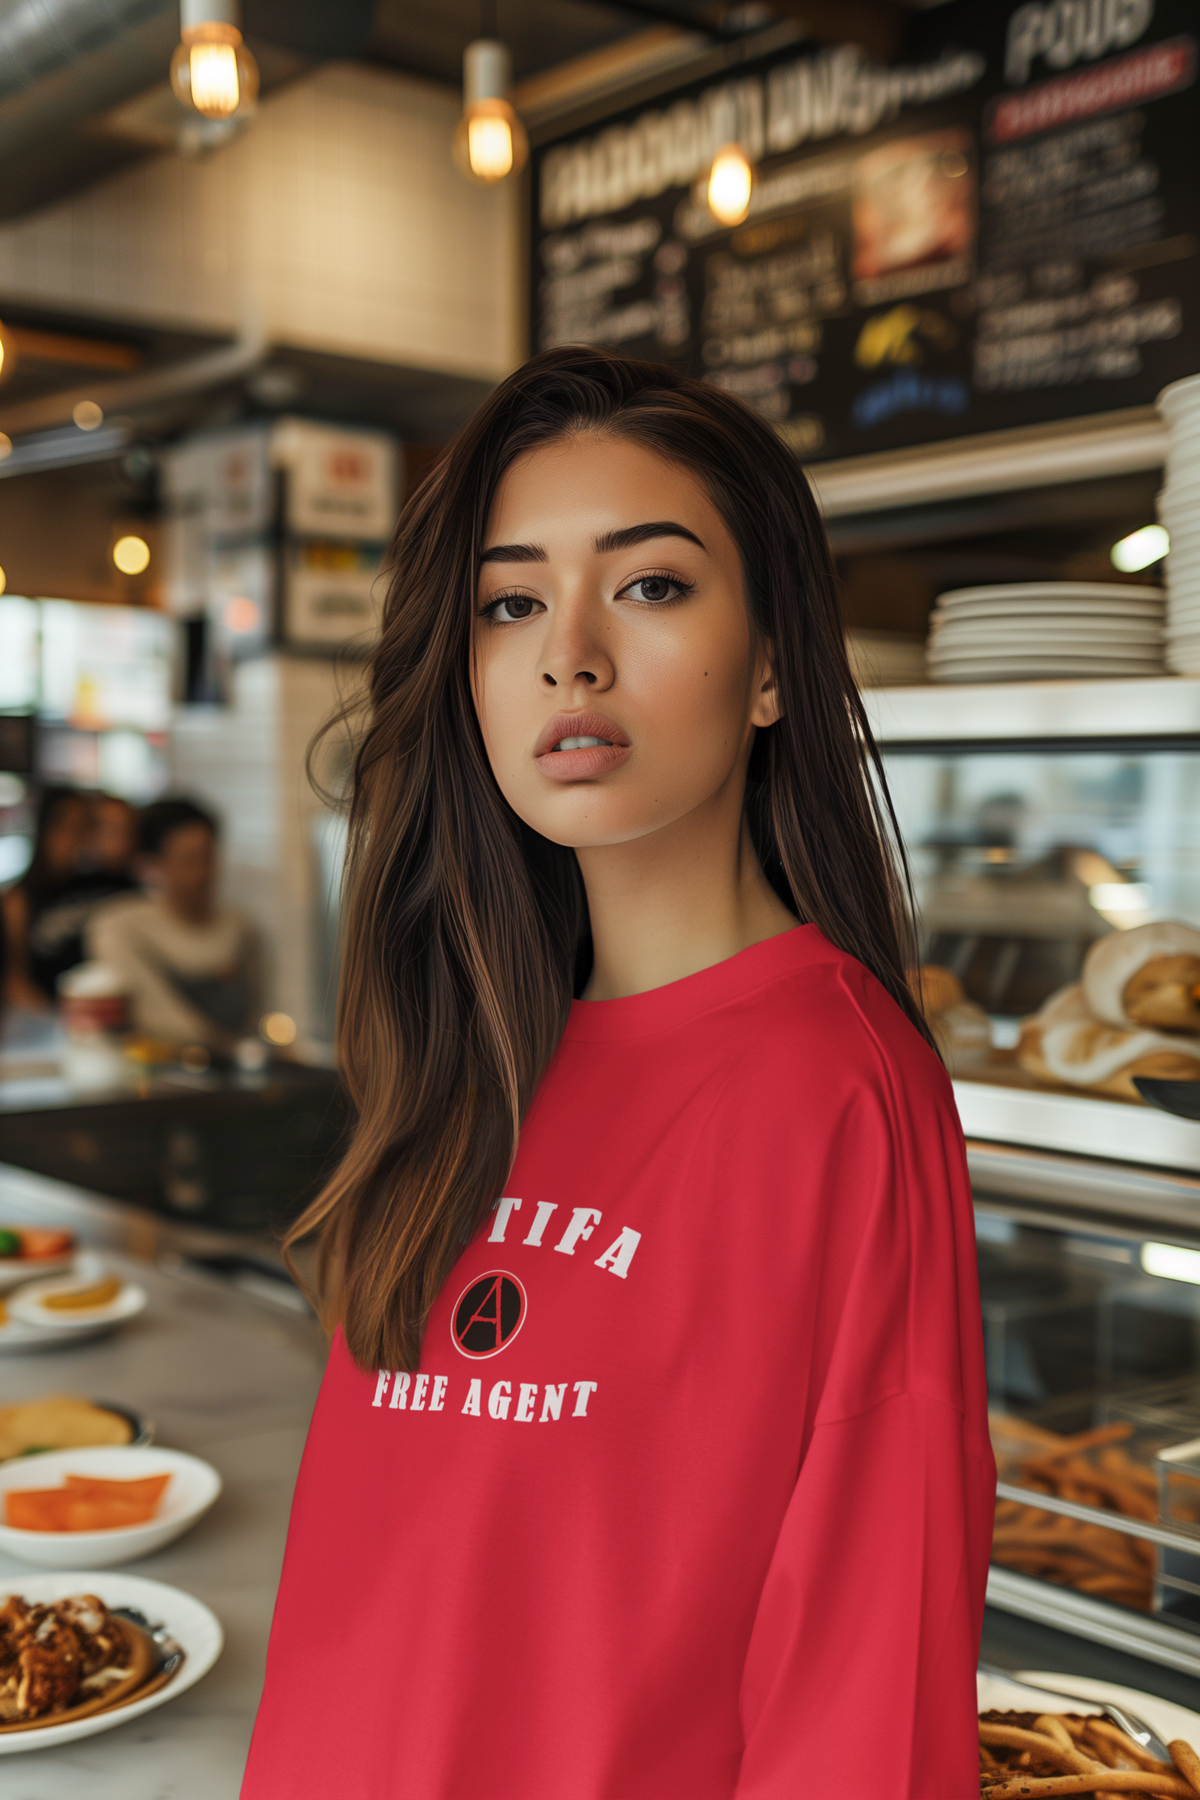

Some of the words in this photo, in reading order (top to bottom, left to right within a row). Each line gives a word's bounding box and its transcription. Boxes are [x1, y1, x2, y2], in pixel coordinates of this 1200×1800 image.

[462, 1197, 642, 1280] TIFA
[371, 1369, 449, 1411] FREE
[460, 1378, 598, 1423] AGENT
